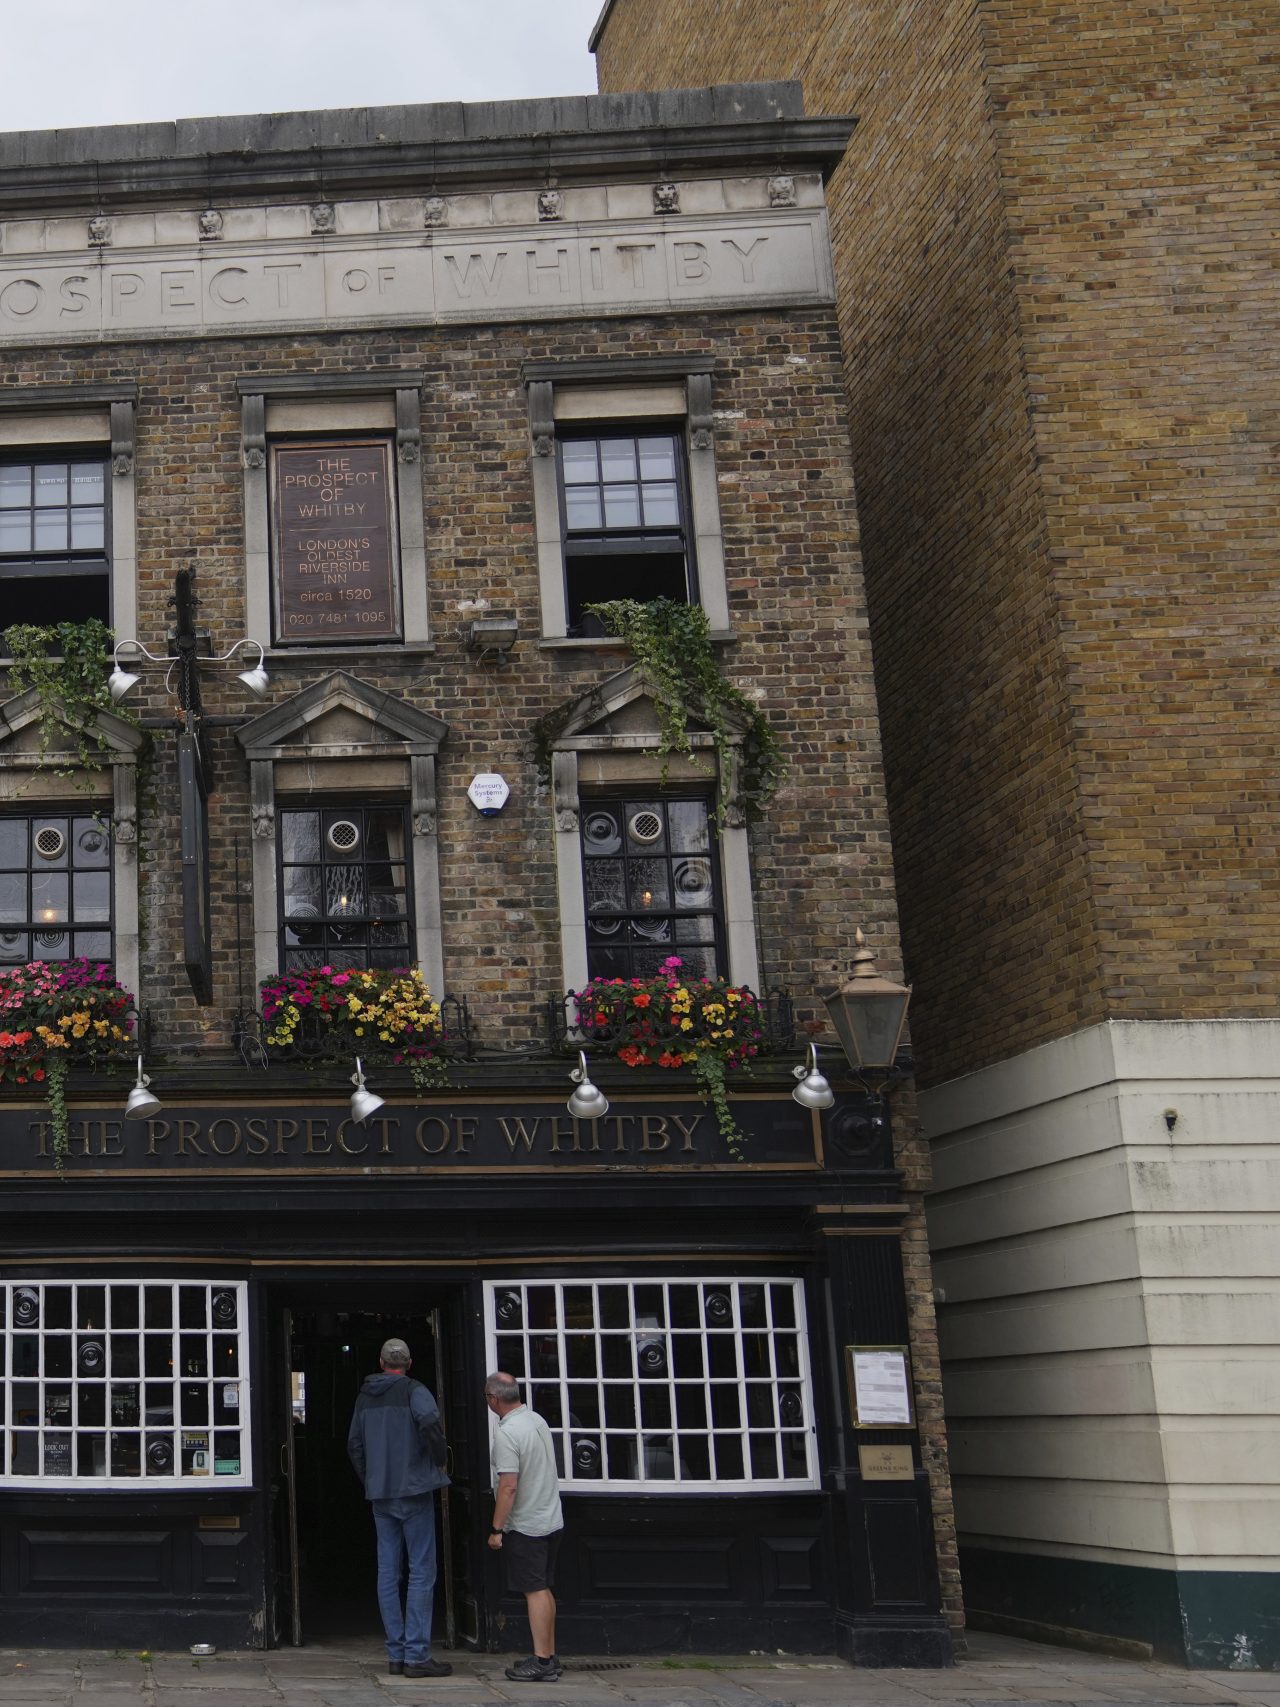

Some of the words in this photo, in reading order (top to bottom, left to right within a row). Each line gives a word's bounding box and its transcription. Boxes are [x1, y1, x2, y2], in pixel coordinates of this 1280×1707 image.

[341, 266, 396, 295] OF
[443, 237, 769, 298] WHITBY
[317, 459, 351, 471] THE
[285, 472, 378, 488] PROSPECT
[321, 489, 343, 501] OF
[298, 503, 366, 517] WHITBY
[299, 538, 370, 551] LONDON'S
[308, 550, 360, 562] OLDEST
[299, 562, 370, 574] RIVERSIDE
[323, 574, 347, 584] INN
[301, 590, 332, 601] circa
[339, 589, 371, 600] 1520
[290, 615, 313, 625] 020
[320, 613, 347, 624] 7481
[355, 612, 385, 623] 1095
[28, 1119, 126, 1157] THE
[143, 1117, 400, 1156] PROSPECT
[415, 1116, 480, 1154] OF
[495, 1114, 705, 1154] WHITBY
